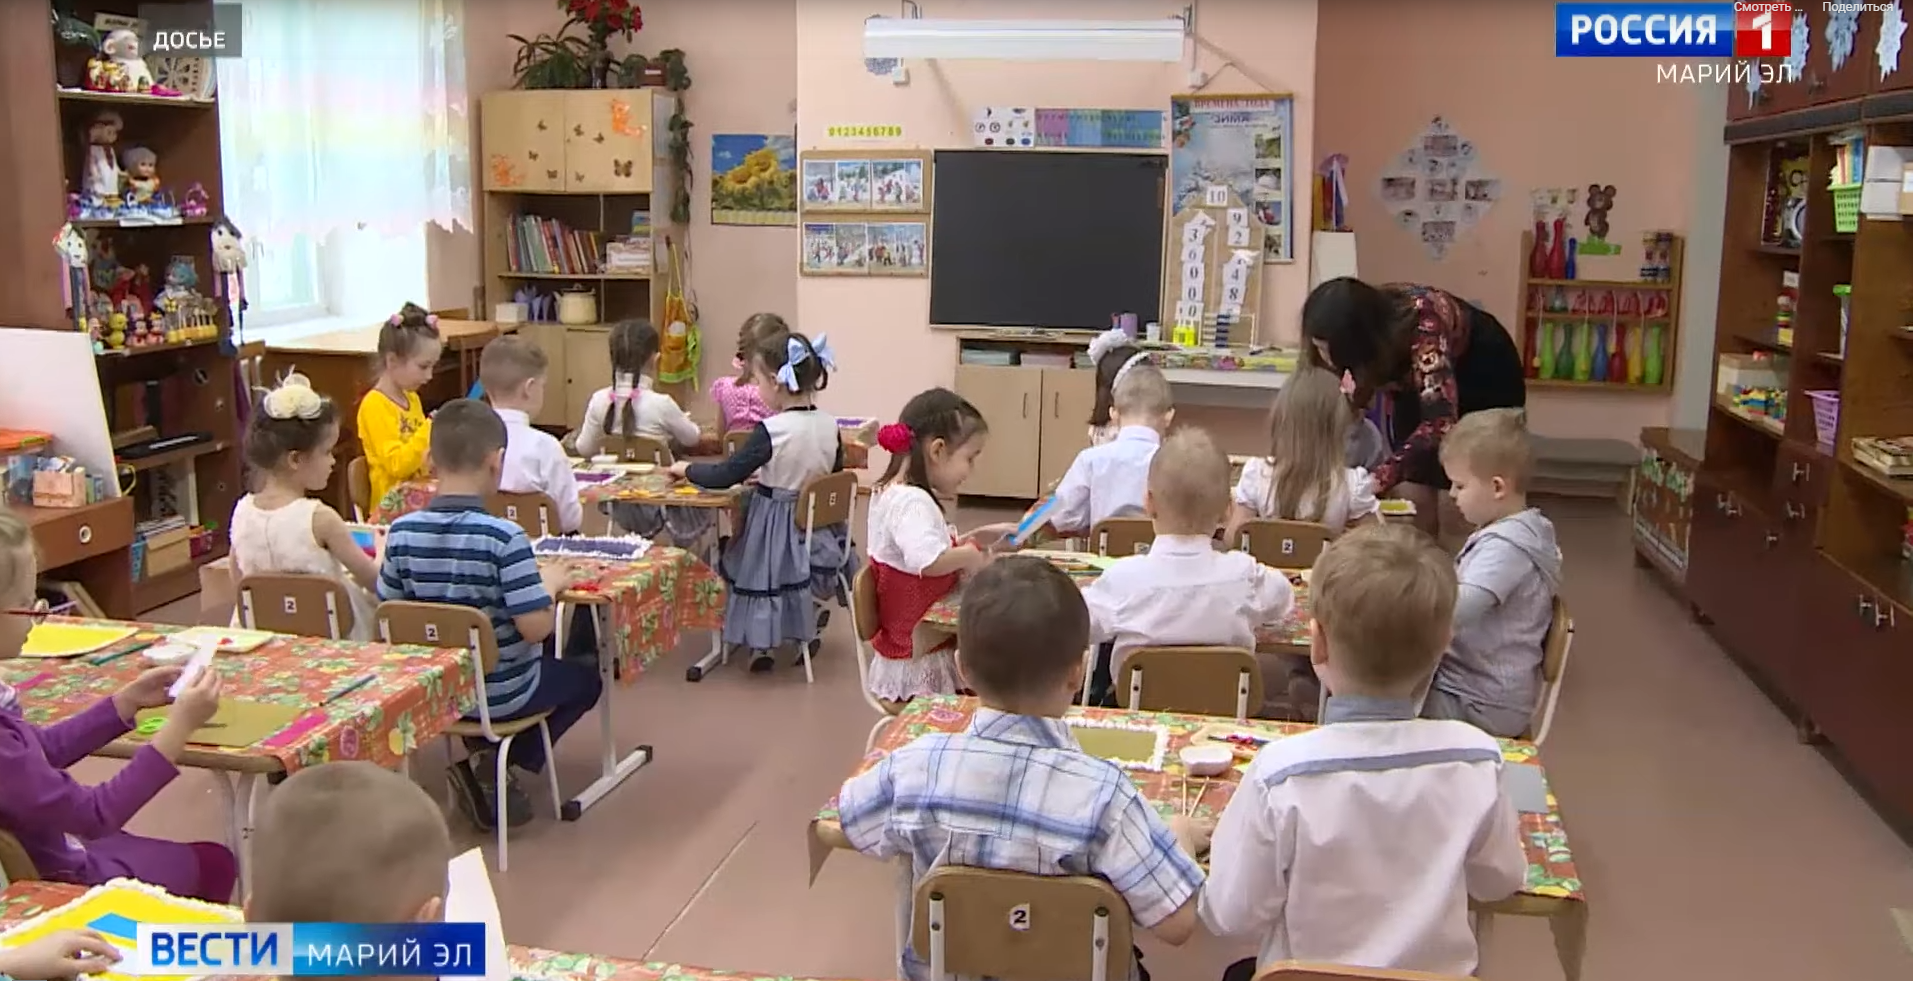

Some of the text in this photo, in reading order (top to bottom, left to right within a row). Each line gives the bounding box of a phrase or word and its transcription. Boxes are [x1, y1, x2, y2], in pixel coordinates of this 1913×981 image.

[1209, 189, 1226, 204] 10
[1232, 212, 1242, 224] 9
[1188, 228, 1199, 243] 3
[1233, 231, 1243, 244] 2
[1231, 268, 1240, 281] 4
[1229, 287, 1239, 300] 8
[286, 600, 295, 611] 2
[428, 627, 437, 638] 2
[1013, 909, 1027, 924] 2
